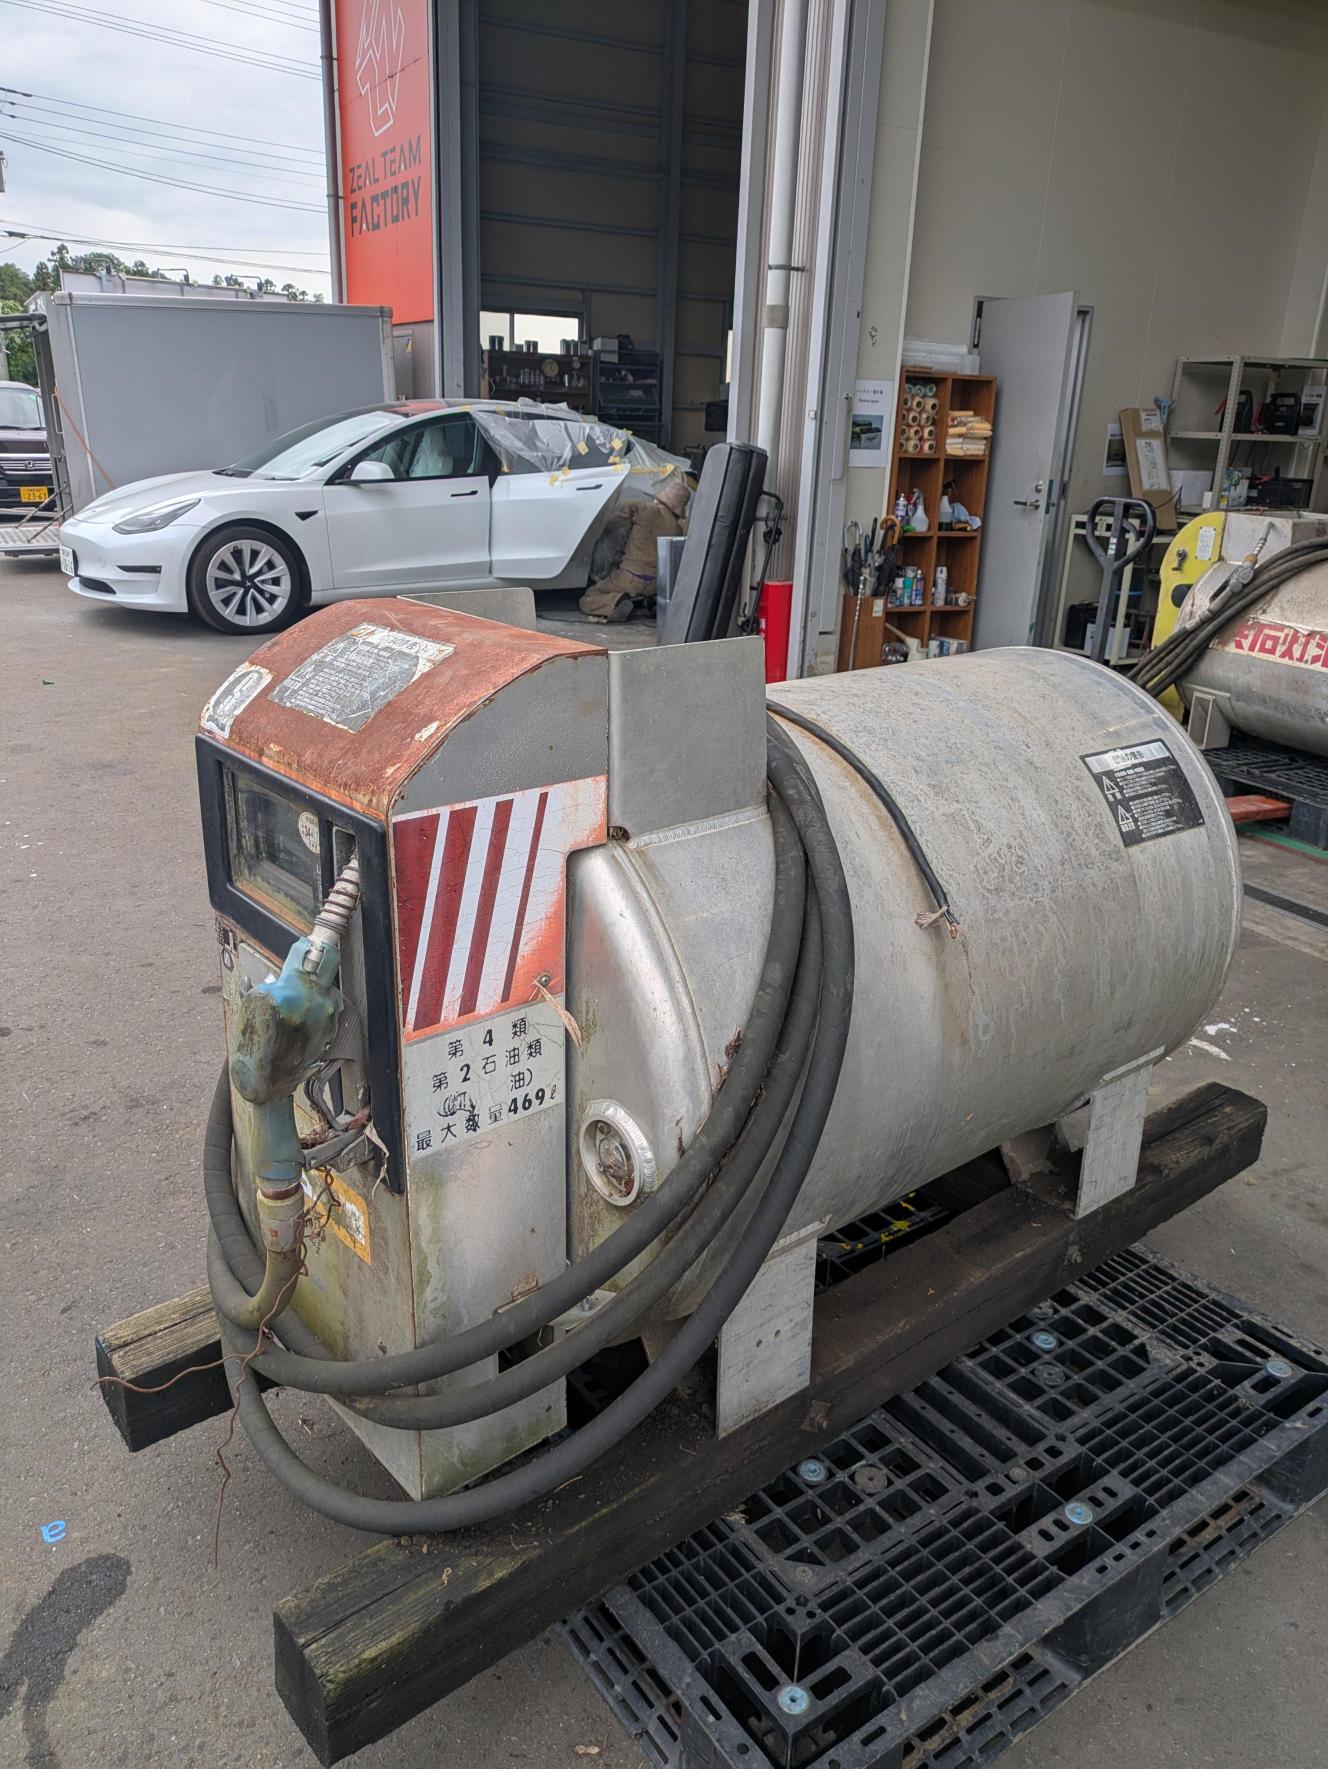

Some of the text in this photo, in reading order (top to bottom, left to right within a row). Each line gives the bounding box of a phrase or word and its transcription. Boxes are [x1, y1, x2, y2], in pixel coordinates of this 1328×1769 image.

[349, 134, 422, 194] ZEAL TEAM
[350, 176, 422, 238] FACTORY
[432, 1038, 543, 1094] 第2石油類
[448, 1016, 528, 1061] 第4類
